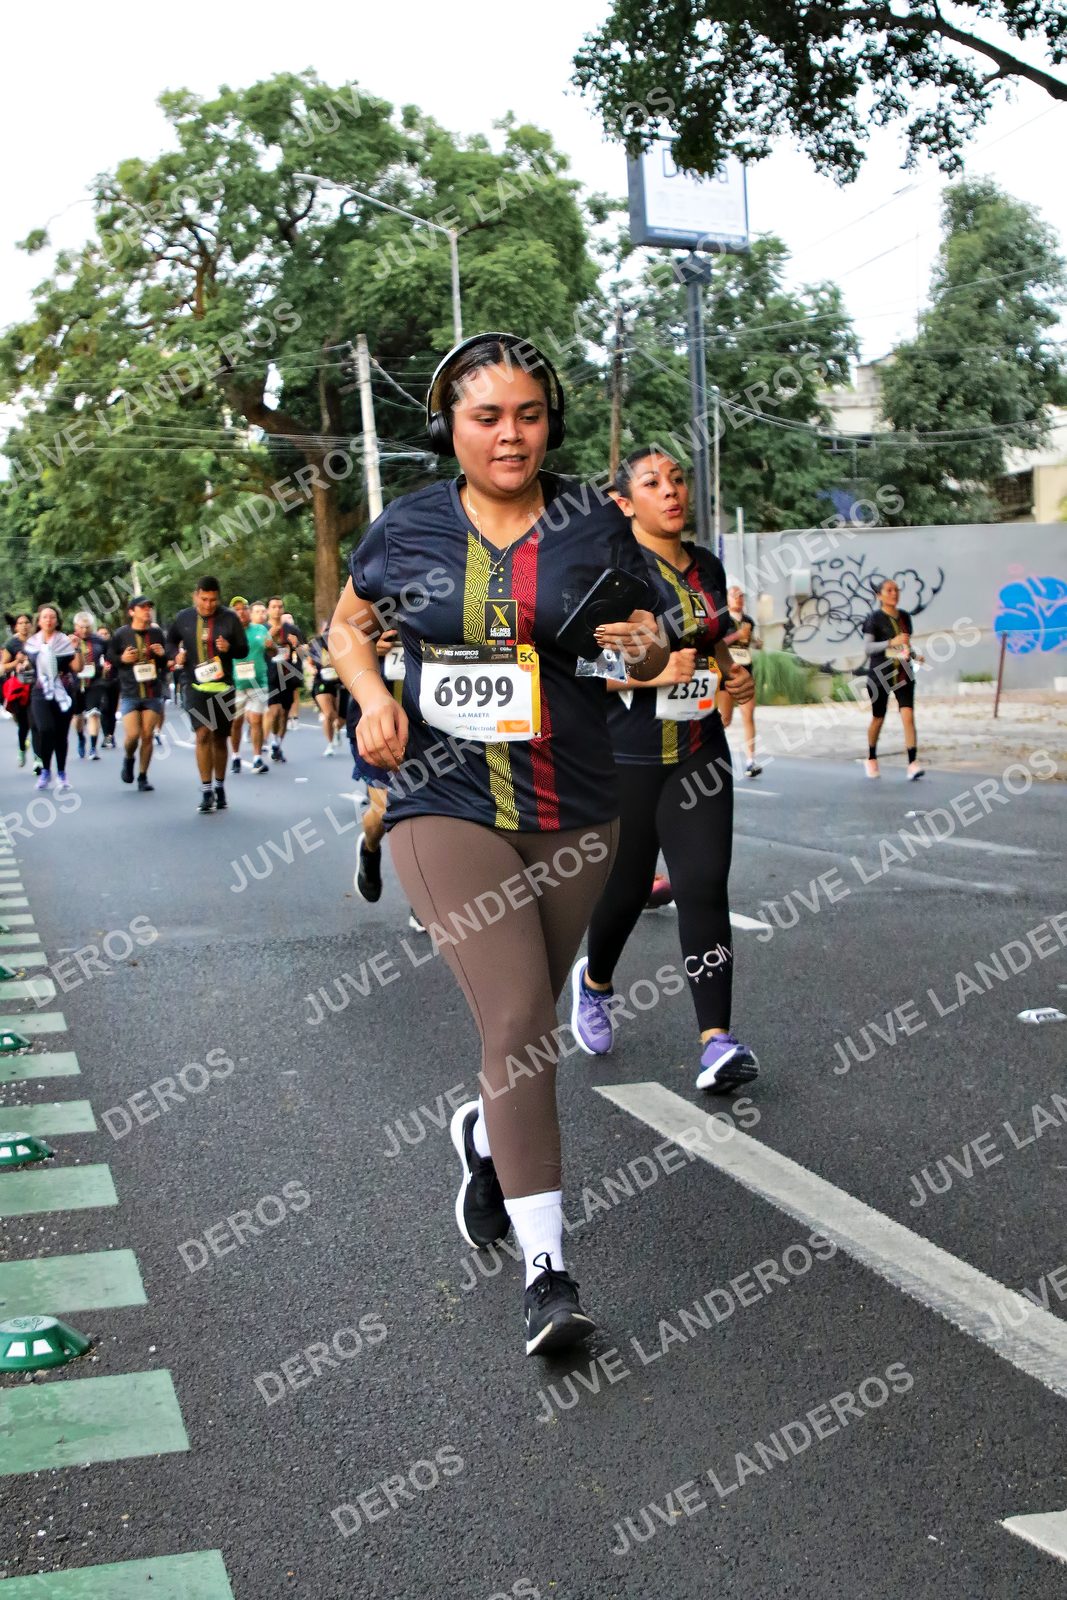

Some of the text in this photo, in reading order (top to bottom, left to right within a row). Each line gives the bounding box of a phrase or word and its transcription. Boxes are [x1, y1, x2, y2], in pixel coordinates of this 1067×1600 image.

[811, 553, 866, 575] TOY
[519, 652, 535, 663] 5K
[434, 675, 514, 708] 6999
[667, 677, 709, 700] 2325
